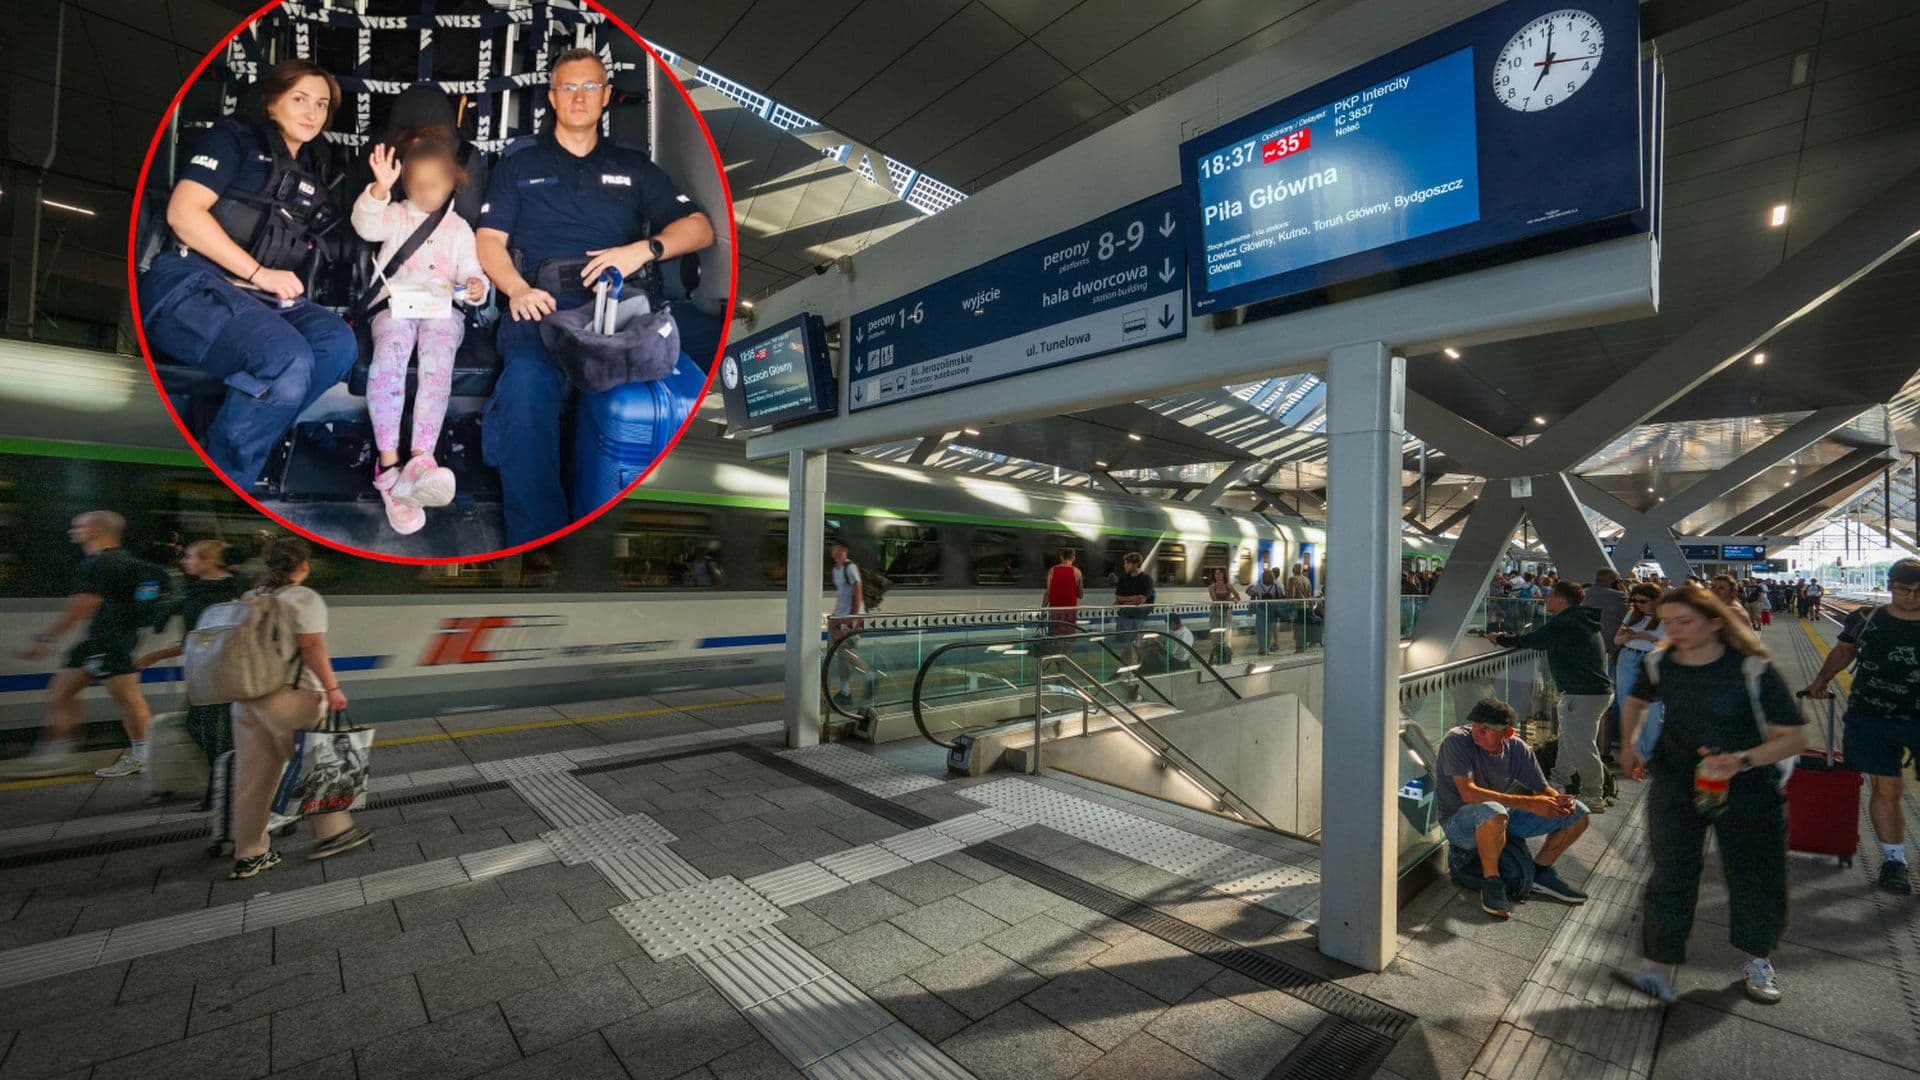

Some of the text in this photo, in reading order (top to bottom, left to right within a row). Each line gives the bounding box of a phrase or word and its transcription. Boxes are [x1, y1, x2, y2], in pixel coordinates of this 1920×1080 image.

[358, 14, 408, 30] WISS
[435, 15, 481, 28] WISS
[439, 80, 487, 94] WISS
[1334, 76, 1410, 115] PKP Intercity
[1335, 103, 1374, 126] IC 3837
[1201, 140, 1257, 179] 18:37
[1204, 167, 1338, 226] Piła Główna
[1207, 178, 1464, 263] Łowicz Główny, Kutno, Toruń Główny, Bydgoszcz
[1043, 220, 1144, 270] perony 8-9
[1208, 259, 1242, 275] Główna
[961, 287, 1001, 311] wyjście
[1042, 265, 1148, 307] hala dworcowa
[867, 301, 925, 333] perony 1-6
[1026, 332, 1091, 357] ul. Tunelowa
